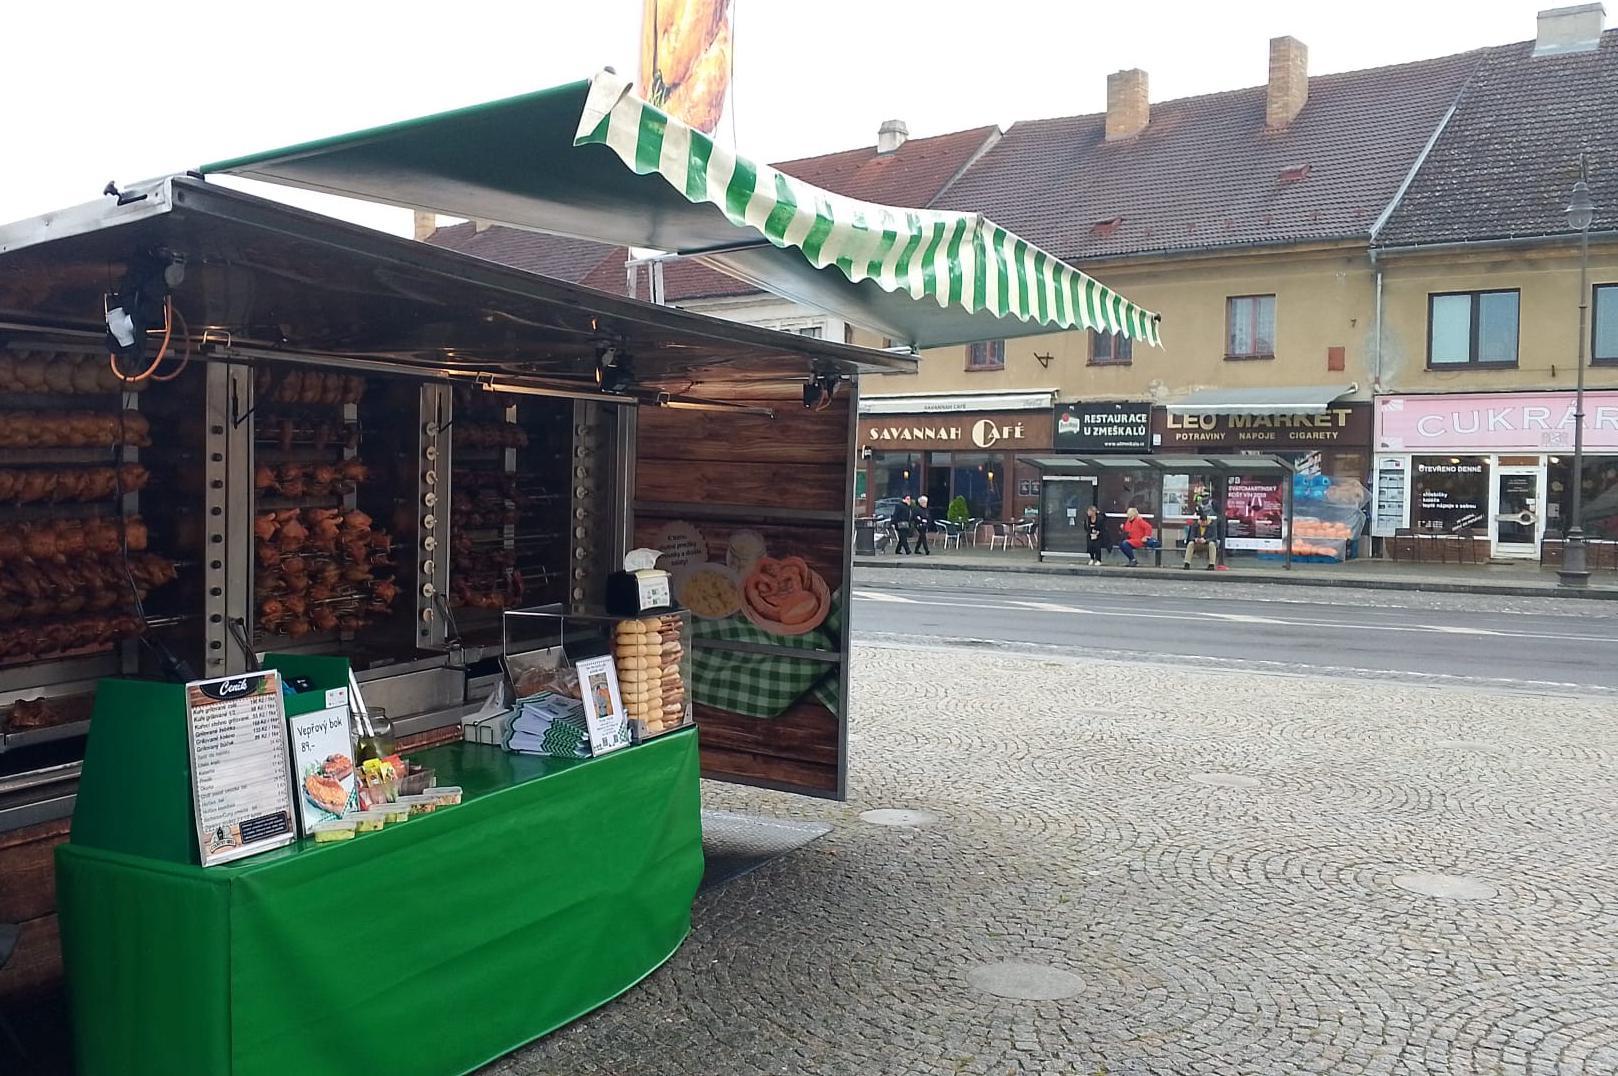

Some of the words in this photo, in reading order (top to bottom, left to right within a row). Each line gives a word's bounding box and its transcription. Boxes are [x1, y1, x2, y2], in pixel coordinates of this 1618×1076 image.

[1084, 413, 1148, 424] RESTAURACE
[1166, 413, 1217, 430] LEO
[1228, 408, 1353, 429] MARKET
[869, 427, 961, 441] SAVANNAH
[971, 419, 1025, 448] CAFÉ
[1083, 427, 1091, 436] U
[1092, 425, 1146, 436] ZMEŠKALŮ
[1175, 432, 1226, 441] POTRAVINY
[1239, 431, 1276, 440] NAPOJE
[1289, 431, 1339, 440] CIGARETY
[1418, 464, 1457, 473] OTEVŘENO
[219, 678, 248, 696] Ceník
[297, 720, 327, 738] Vepřový
[328, 716, 342, 729] bok
[301, 741, 315, 752] 89,-
